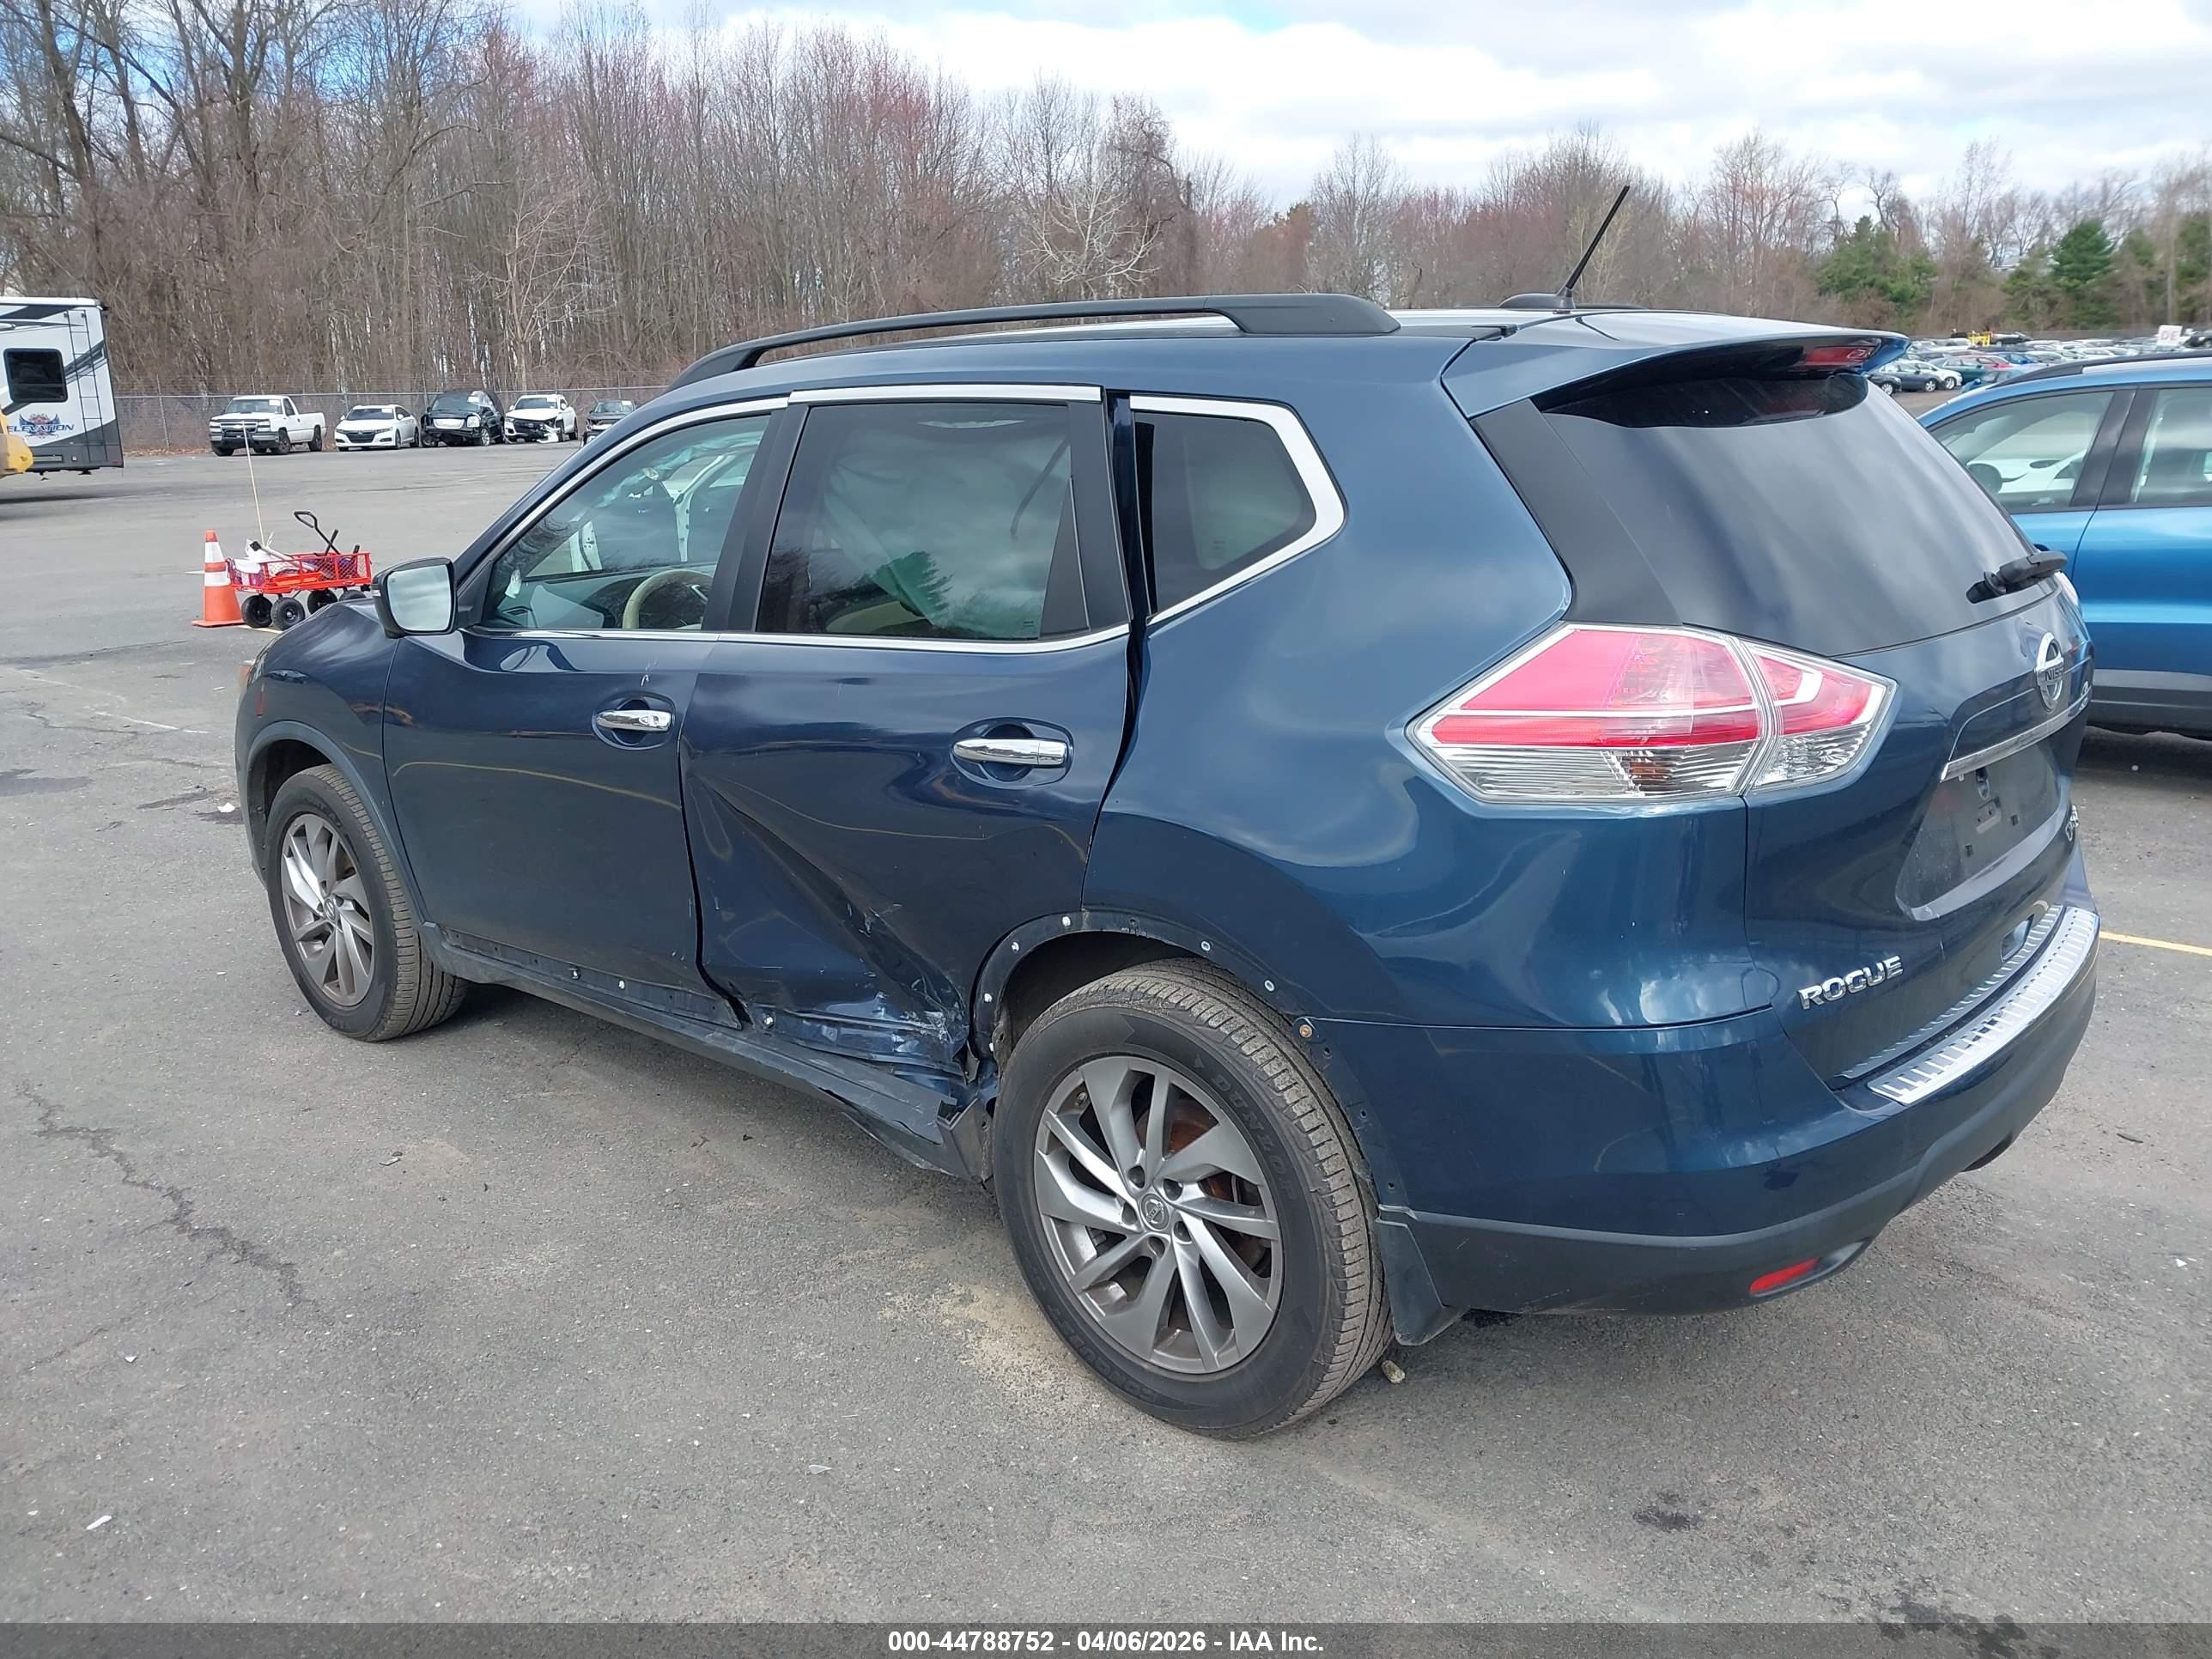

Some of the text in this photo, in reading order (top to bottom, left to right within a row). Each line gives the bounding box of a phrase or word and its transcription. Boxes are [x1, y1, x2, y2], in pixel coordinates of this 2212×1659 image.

[7, 424, 73, 433] ELEVATION
[1798, 955, 1904, 1010] ROGUE
[1210, 1073, 1299, 1201] DUNLOP
